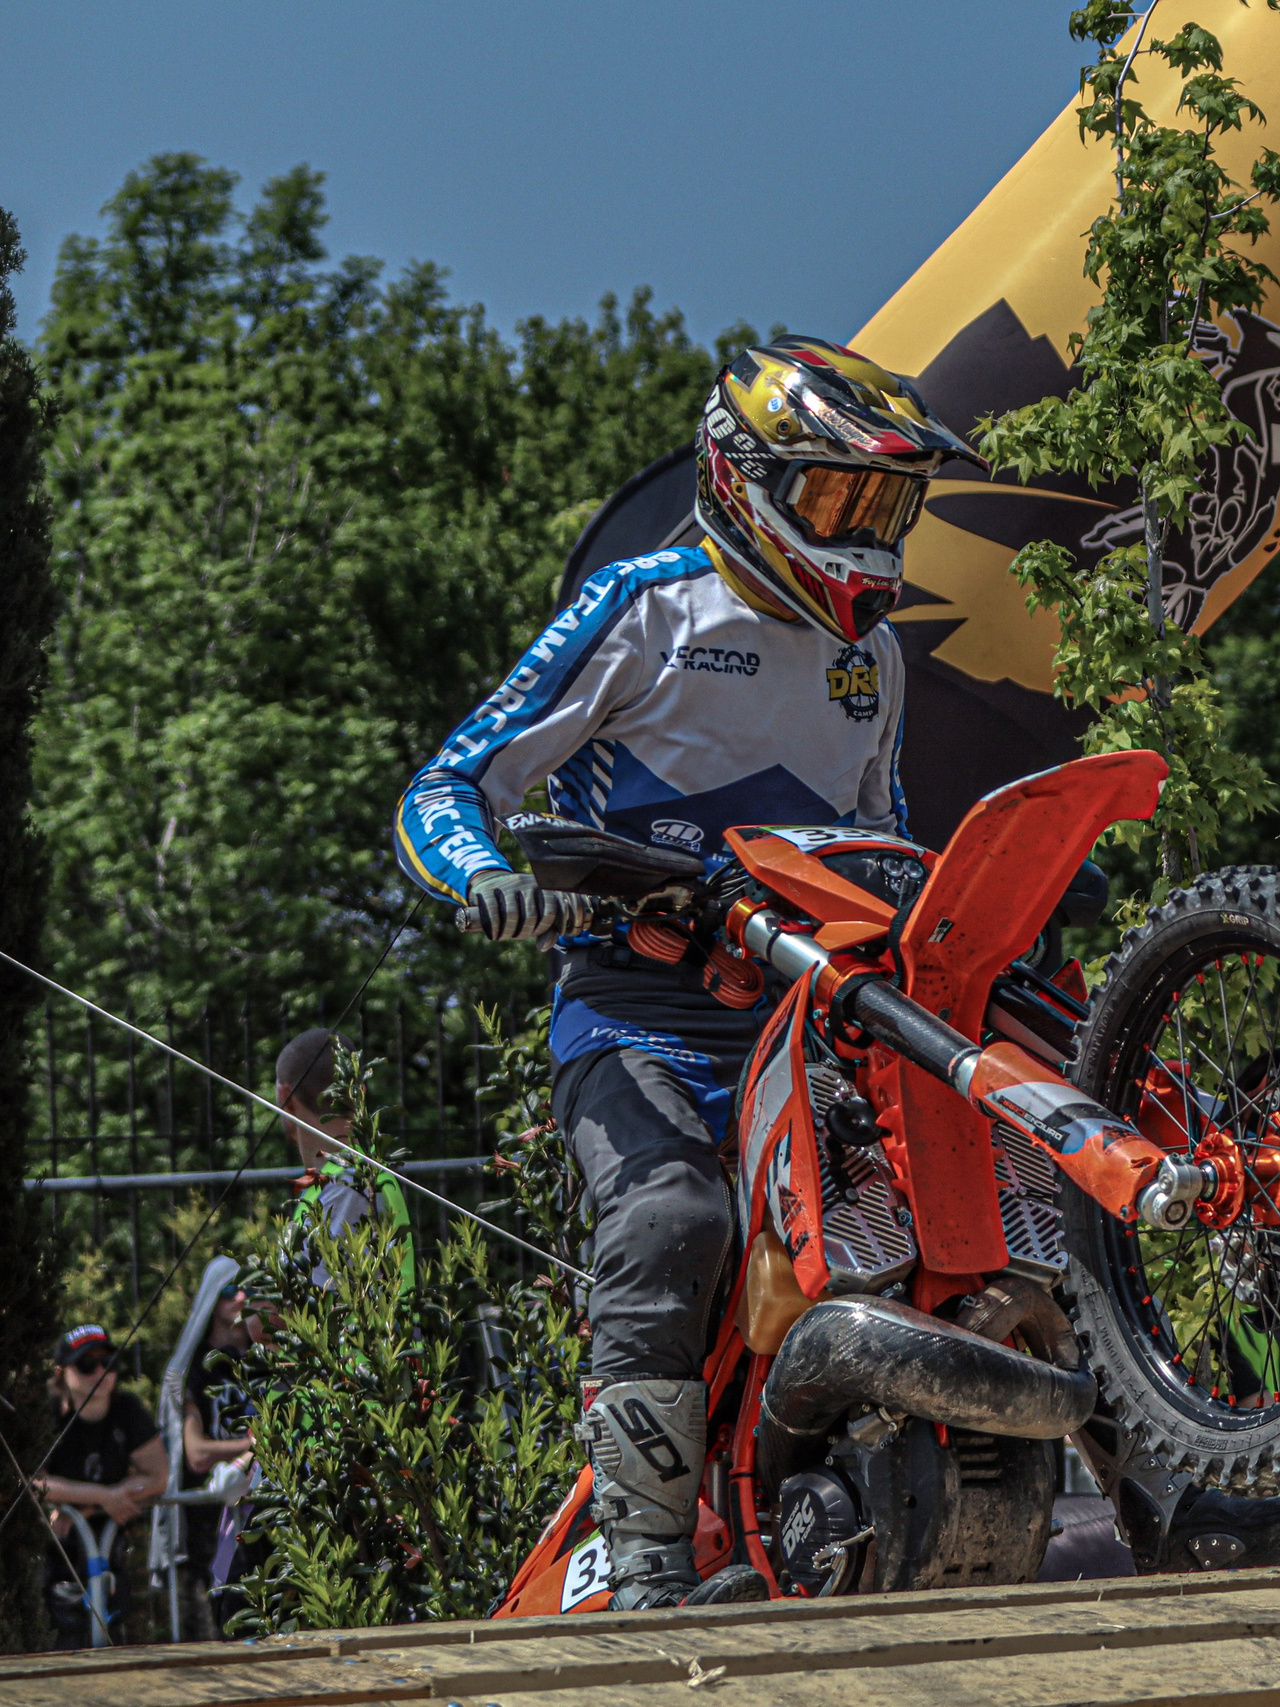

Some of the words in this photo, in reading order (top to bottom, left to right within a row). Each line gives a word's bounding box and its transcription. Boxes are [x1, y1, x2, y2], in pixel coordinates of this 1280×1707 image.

[530, 579, 615, 663] TEAM
[473, 665, 541, 733] DRC
[682, 659, 759, 677] RACING
